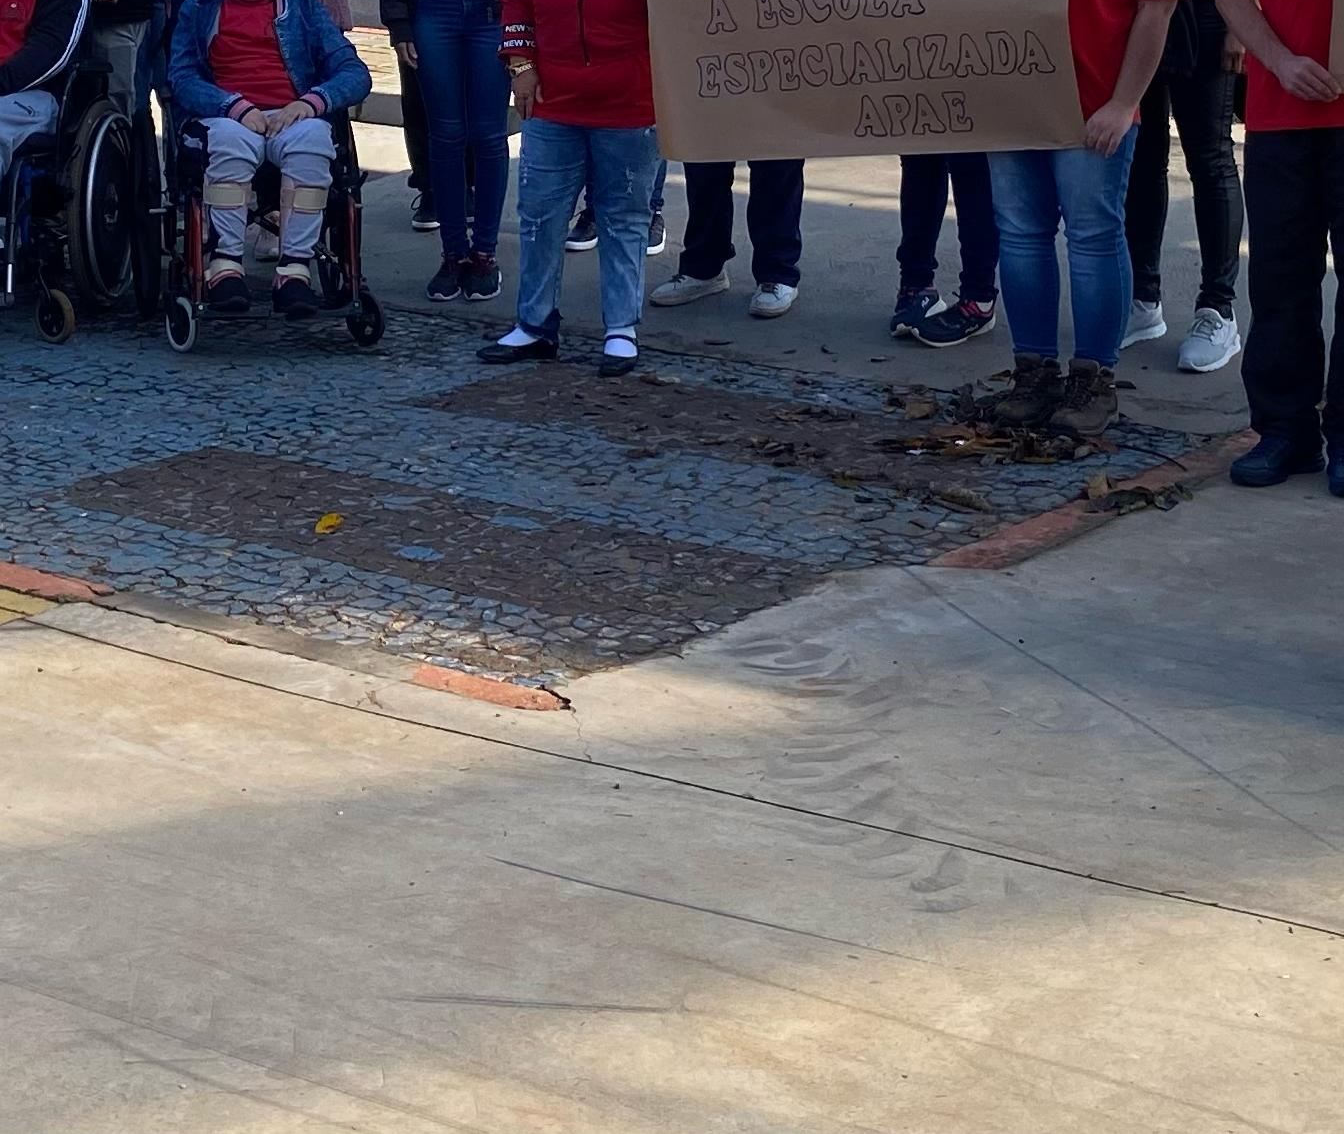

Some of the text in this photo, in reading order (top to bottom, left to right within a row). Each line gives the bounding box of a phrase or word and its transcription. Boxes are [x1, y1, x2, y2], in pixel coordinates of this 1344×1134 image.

[505, 24, 526, 33] NEW
[503, 39, 524, 48] NEW
[696, 29, 1057, 98] ESPECIALIZADA
[854, 91, 974, 137] APAE
